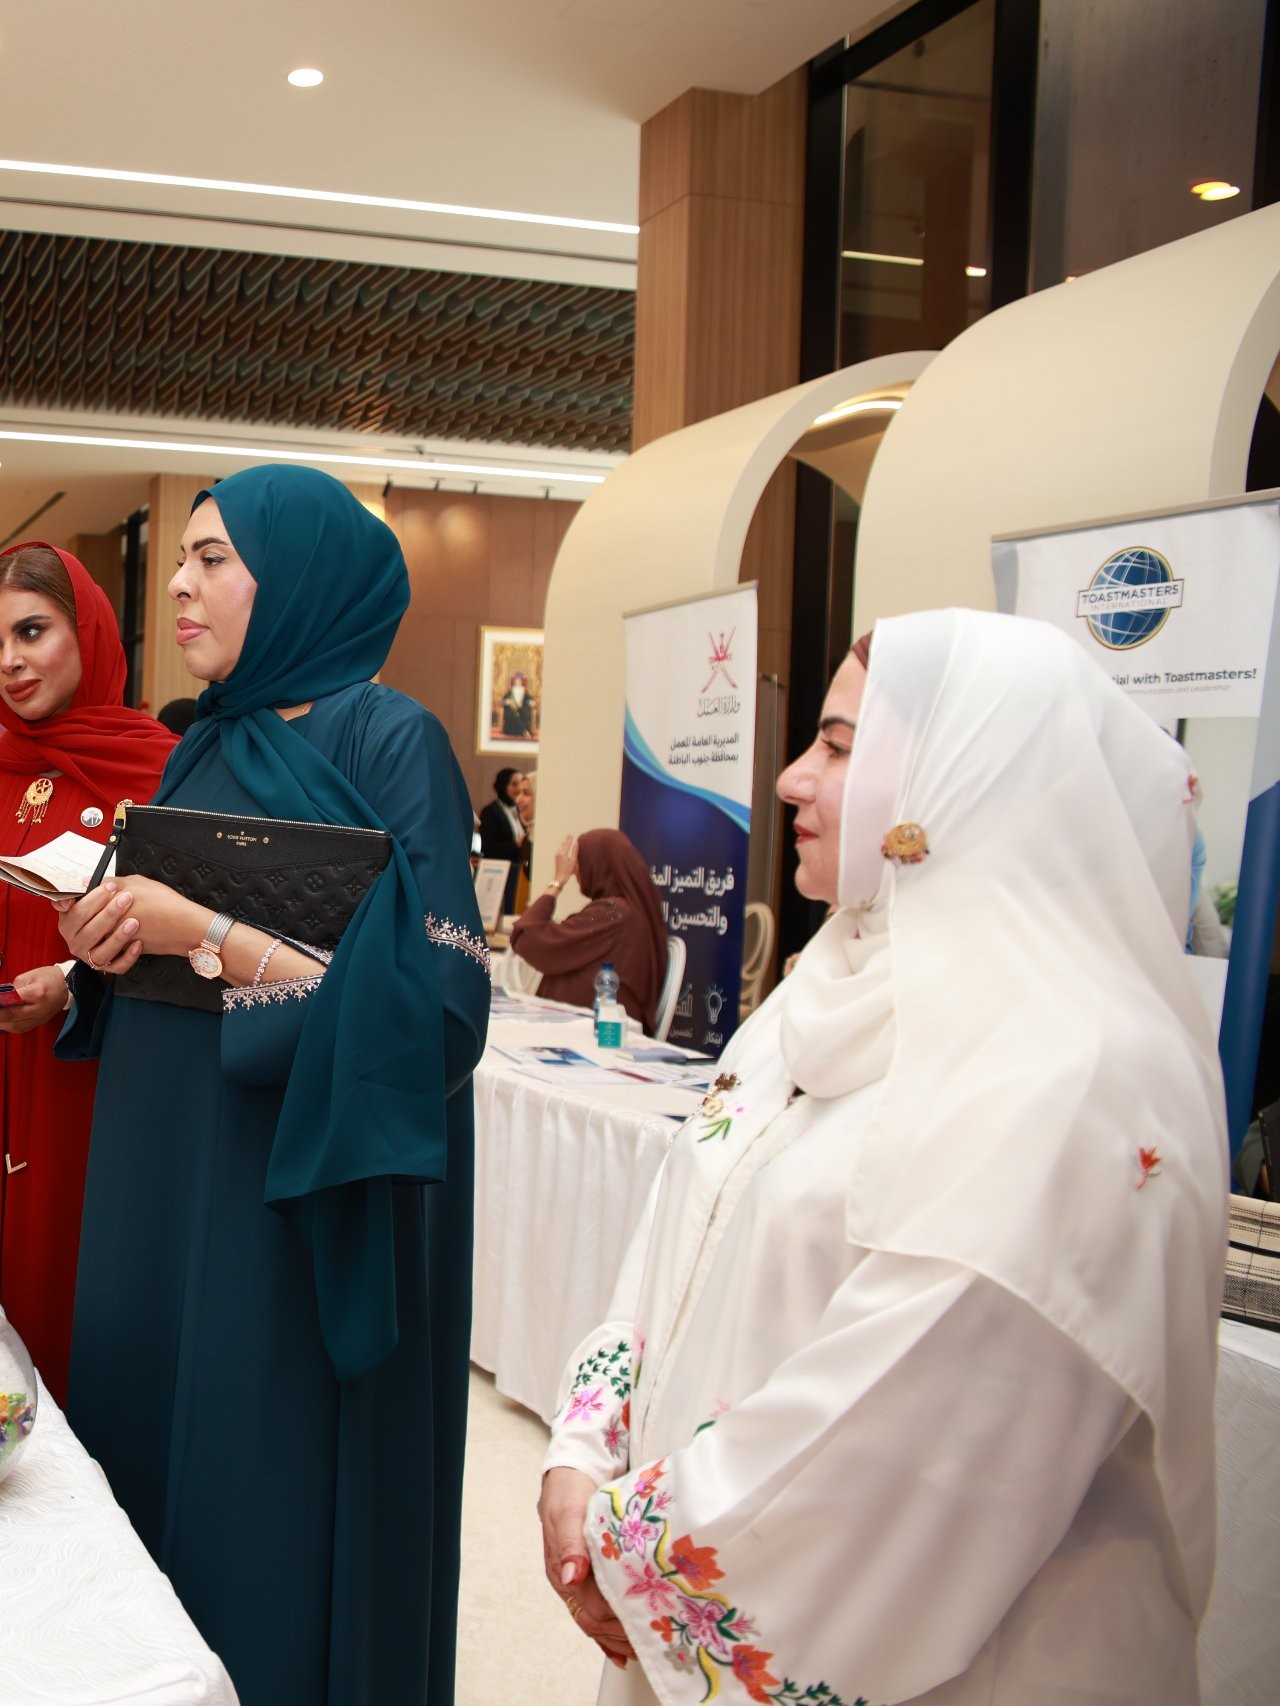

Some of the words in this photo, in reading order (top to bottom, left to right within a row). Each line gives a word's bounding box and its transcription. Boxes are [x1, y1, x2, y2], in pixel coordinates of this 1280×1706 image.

[1081, 584, 1180, 605] TOASTMASTERS
[1090, 598, 1168, 611] INTERNATIONAL
[1133, 672, 1162, 685] with
[1164, 667, 1258, 683] Toastmasters!
[670, 736, 691, 752] للعمل
[691, 734, 712, 747] العامة
[713, 731, 740, 748] المديرية
[668, 752, 691, 767] الباطنة
[692, 754, 710, 767] جنوب
[711, 751, 739, 764] بمحافظة
[670, 865, 705, 894] التميز
[704, 865, 735, 897] فريق
[669, 905, 728, 936] والتحسين
